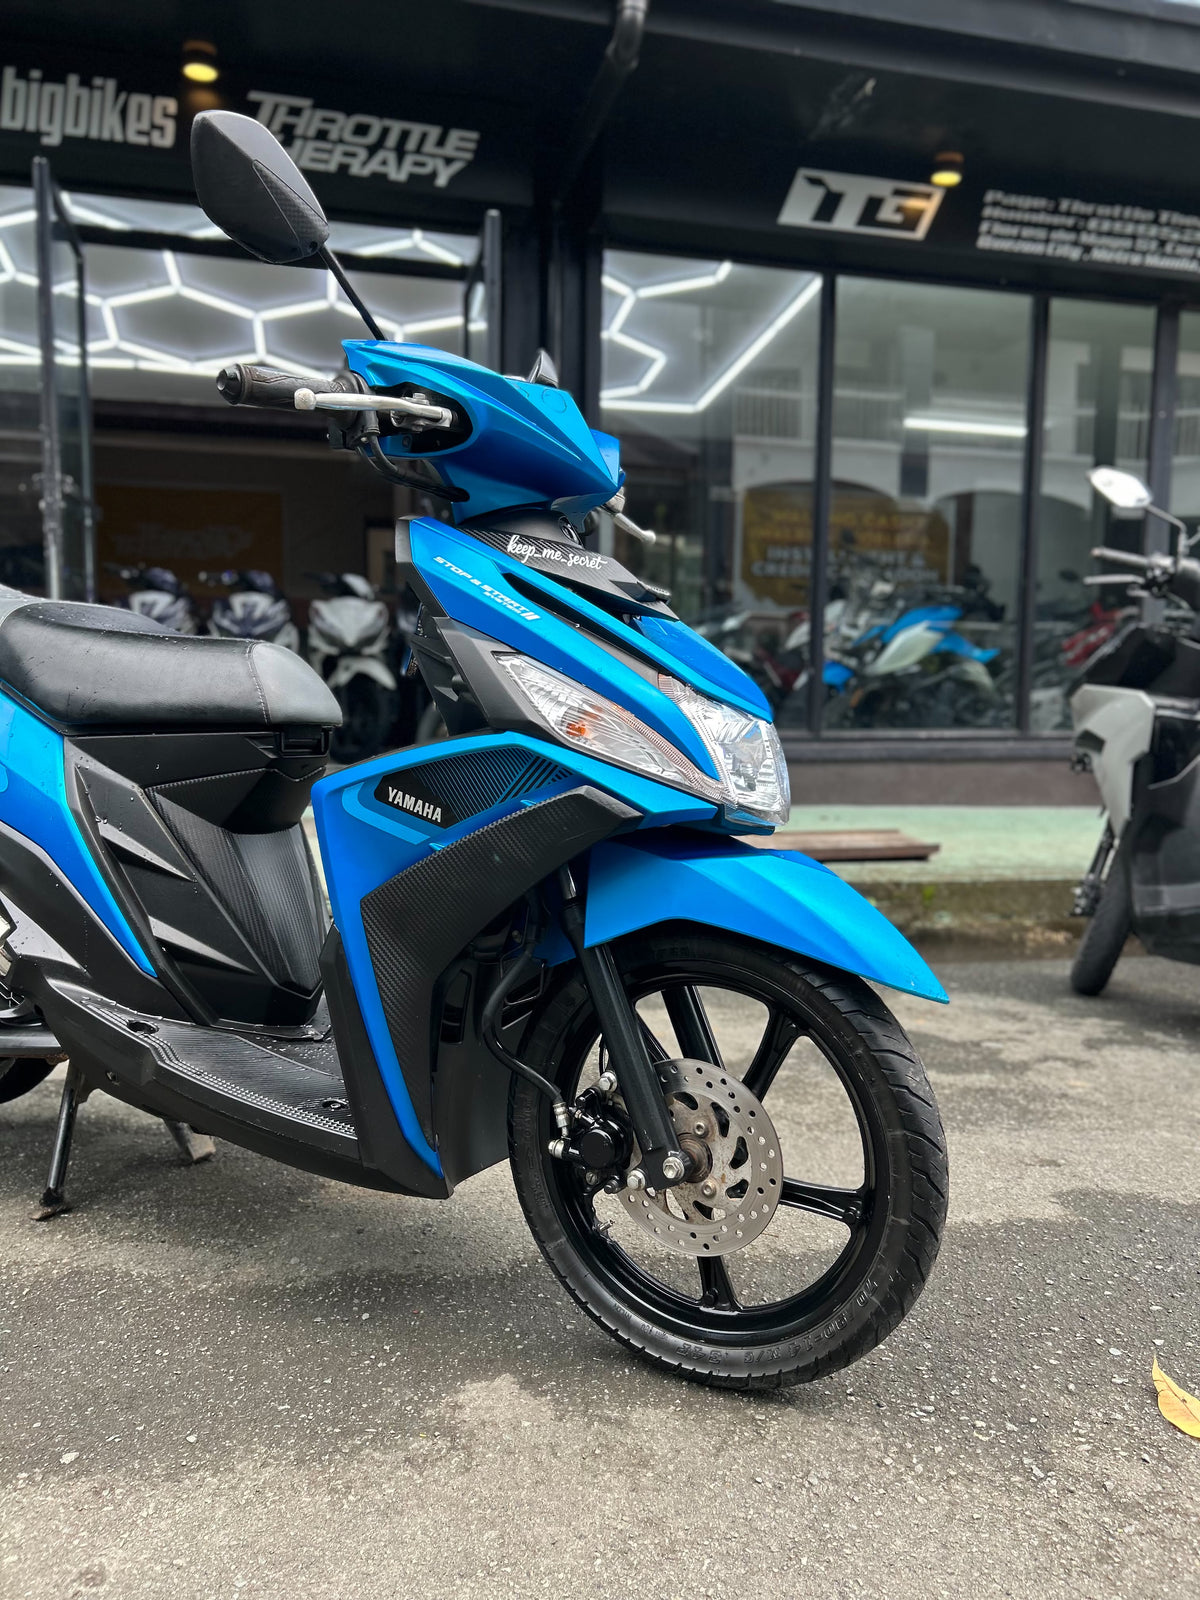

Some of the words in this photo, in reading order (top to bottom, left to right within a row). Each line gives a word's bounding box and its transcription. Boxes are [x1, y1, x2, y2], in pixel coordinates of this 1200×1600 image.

[1, 65, 179, 149] bigbikes
[247, 90, 481, 161] THROTTLE
[507, 534, 608, 570] keep_me_secret
[433, 556, 474, 579] STOP
[480, 584, 531, 612] START
[388, 786, 442, 823] YAMAHA
